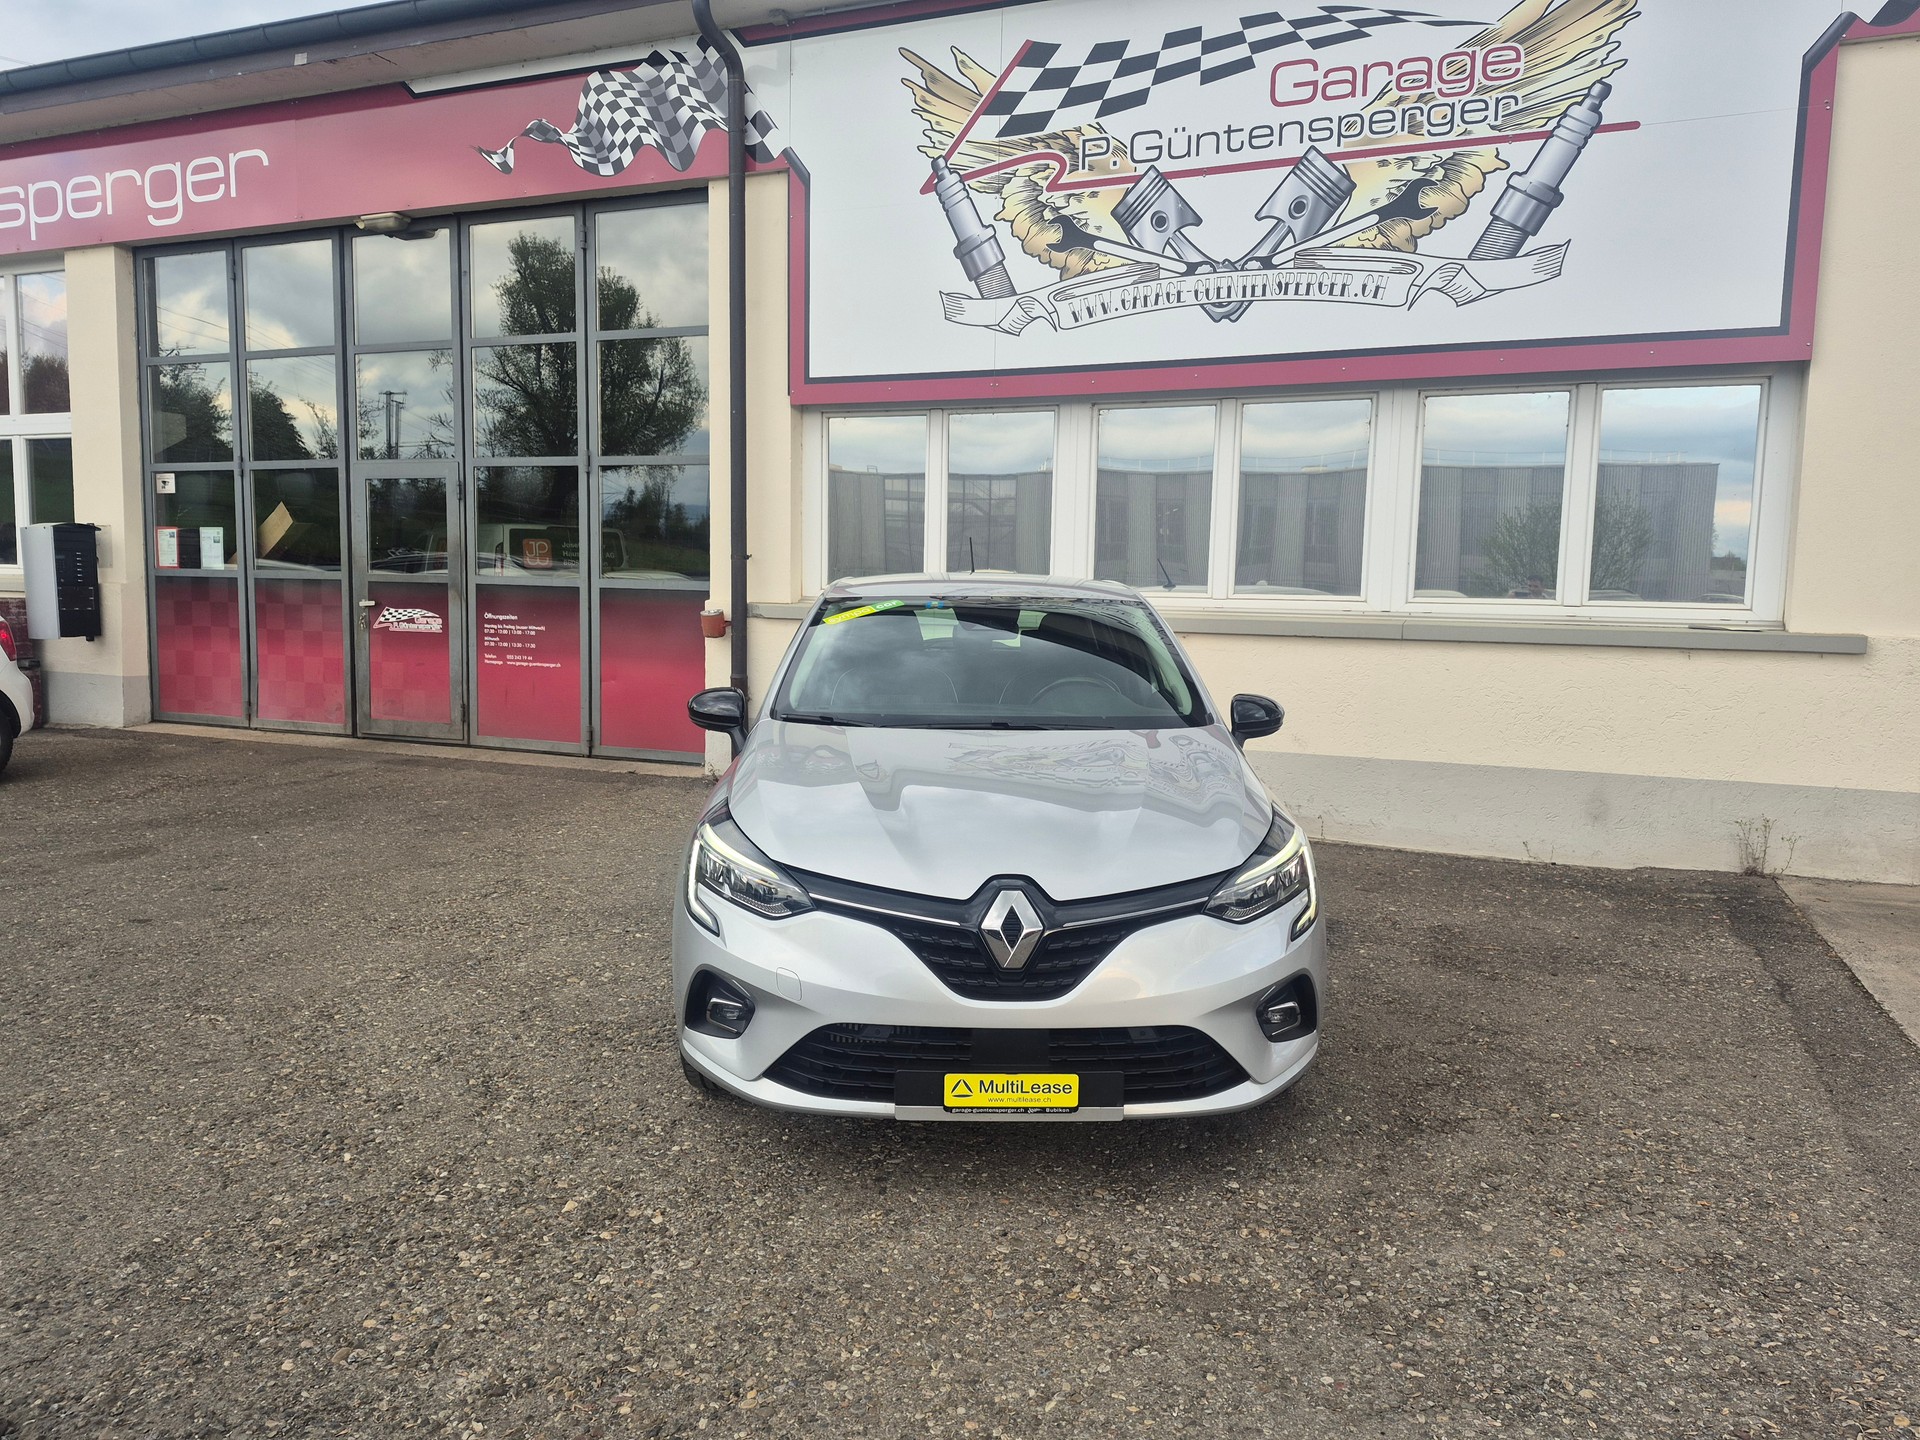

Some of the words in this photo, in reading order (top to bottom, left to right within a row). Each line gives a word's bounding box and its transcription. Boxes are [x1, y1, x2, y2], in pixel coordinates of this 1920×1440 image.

[1270, 45, 1522, 107] Garage
[1081, 134, 1118, 171] P.
[1129, 94, 1518, 164] Güntensperger
[0, 148, 270, 241] sperger
[1068, 272, 1390, 324] WWW.GARAGE-GUENTENSPERGER.CH
[484, 612, 518, 620] Öffnungszeiten
[979, 1079, 1073, 1094] MultiLease
